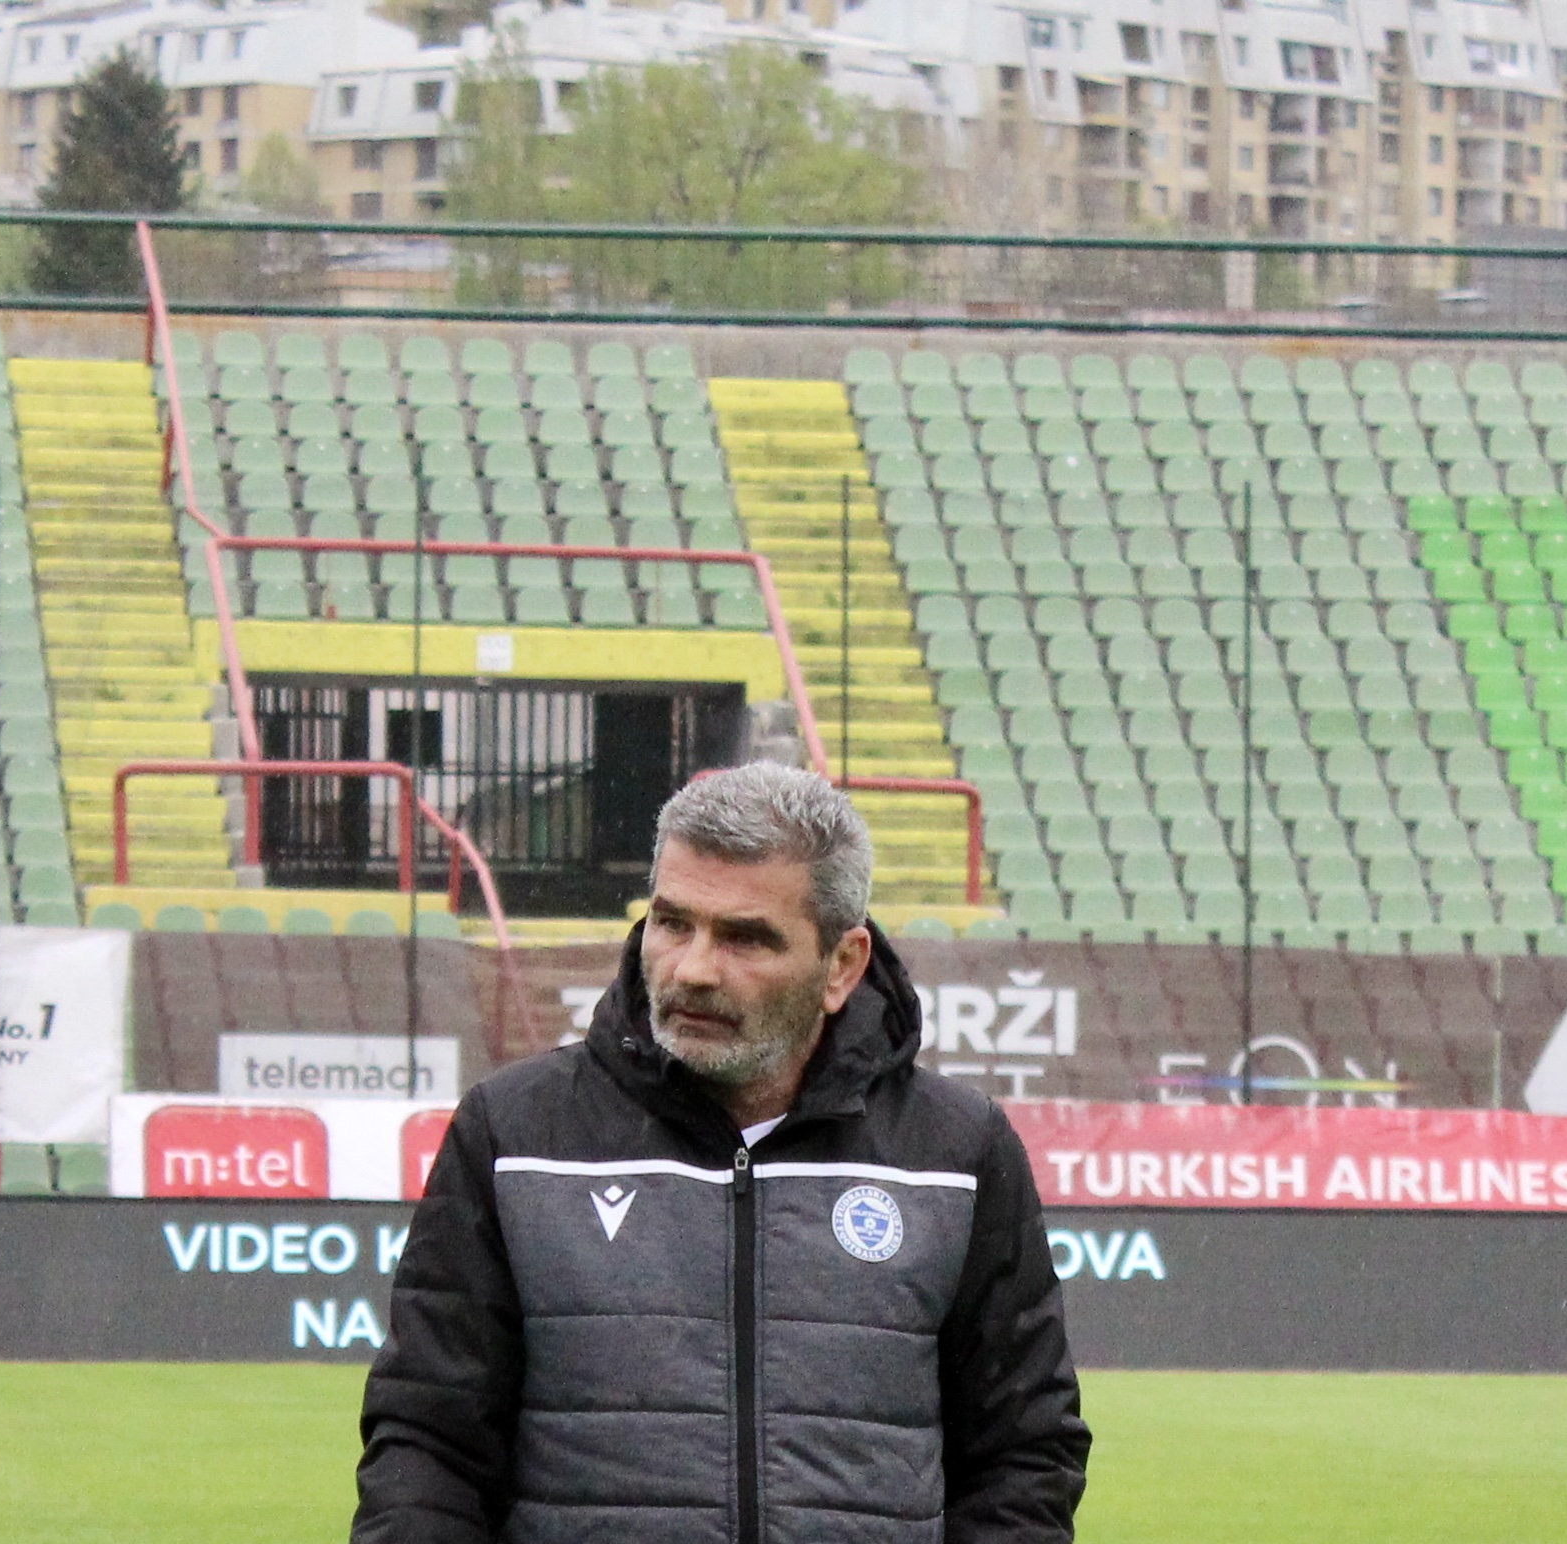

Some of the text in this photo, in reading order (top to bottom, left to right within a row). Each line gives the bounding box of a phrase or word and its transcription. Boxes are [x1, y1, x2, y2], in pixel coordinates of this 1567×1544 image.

[245, 1056, 434, 1091] telemach
[163, 1140, 309, 1188] m:tel
[1047, 1151, 1307, 1200] TURKISH
[163, 1221, 358, 1275] VIDEO
